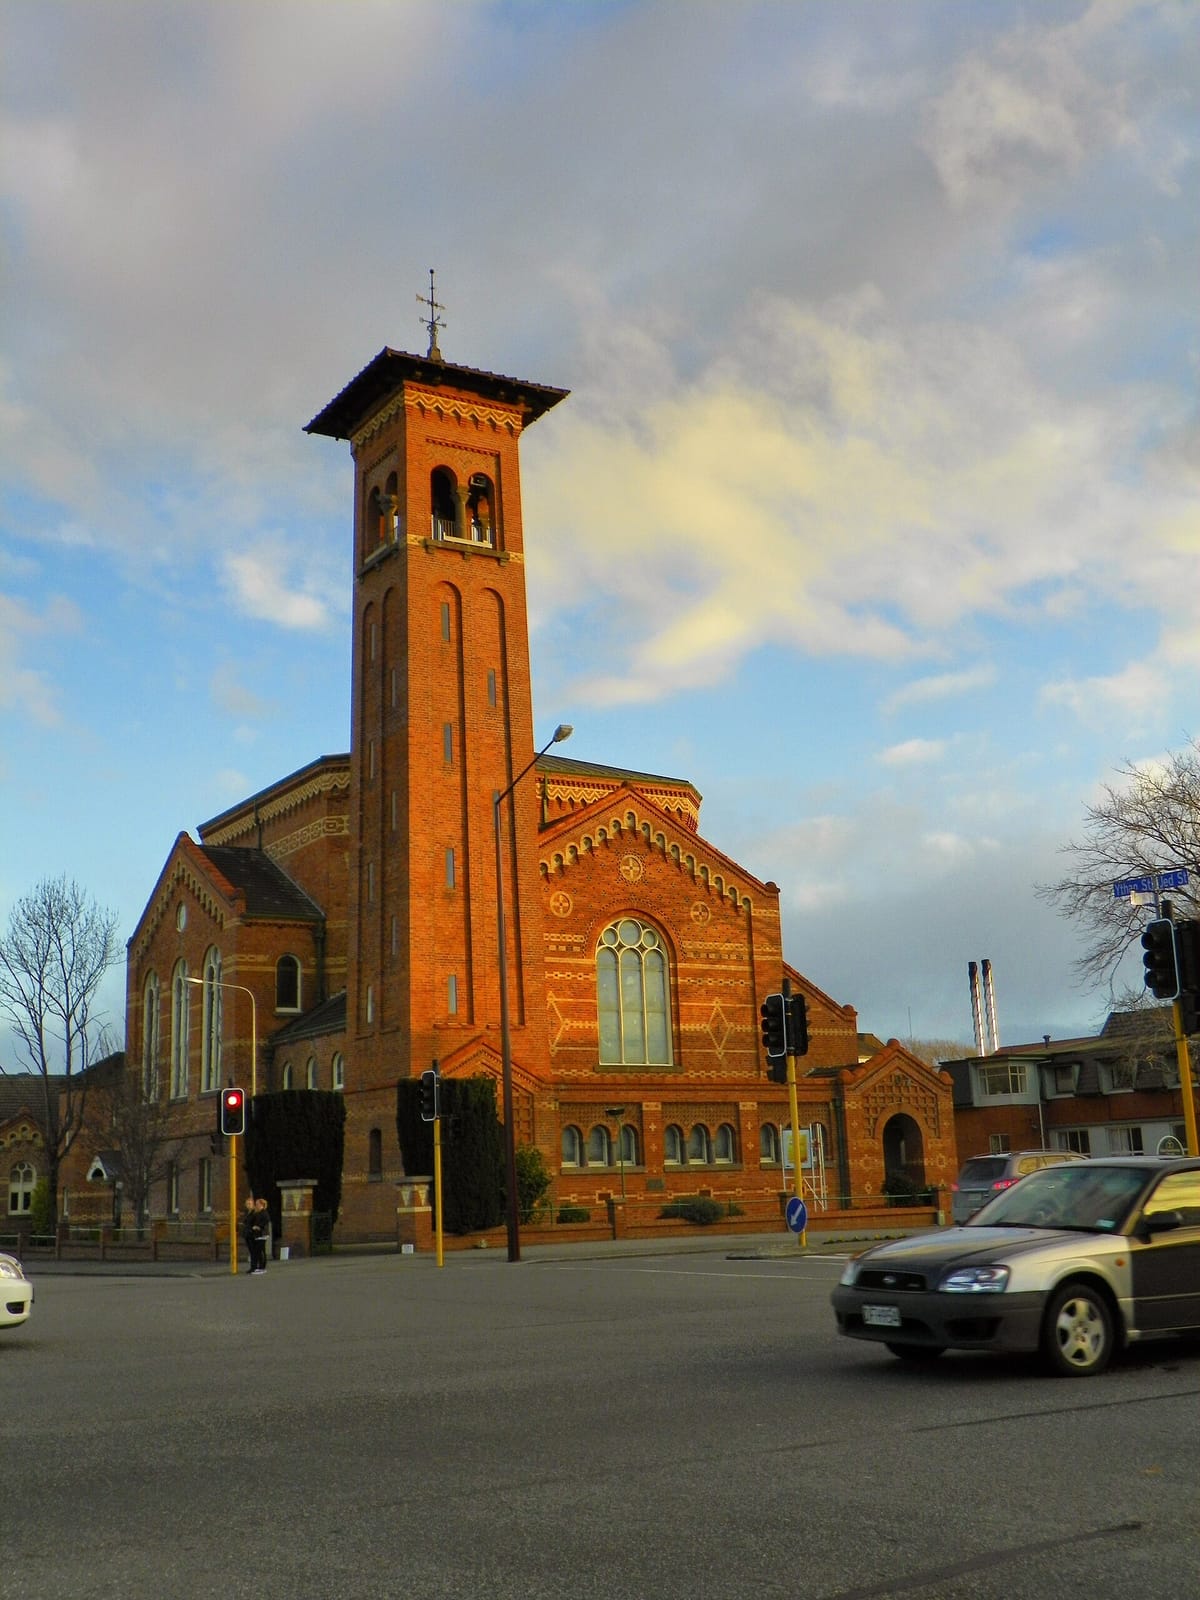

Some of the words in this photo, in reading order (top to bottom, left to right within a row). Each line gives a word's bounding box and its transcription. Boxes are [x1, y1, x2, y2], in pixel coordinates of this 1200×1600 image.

[1141, 878, 1152, 891] St
[1159, 876, 1174, 888] Jed
[1177, 872, 1188, 885] St
